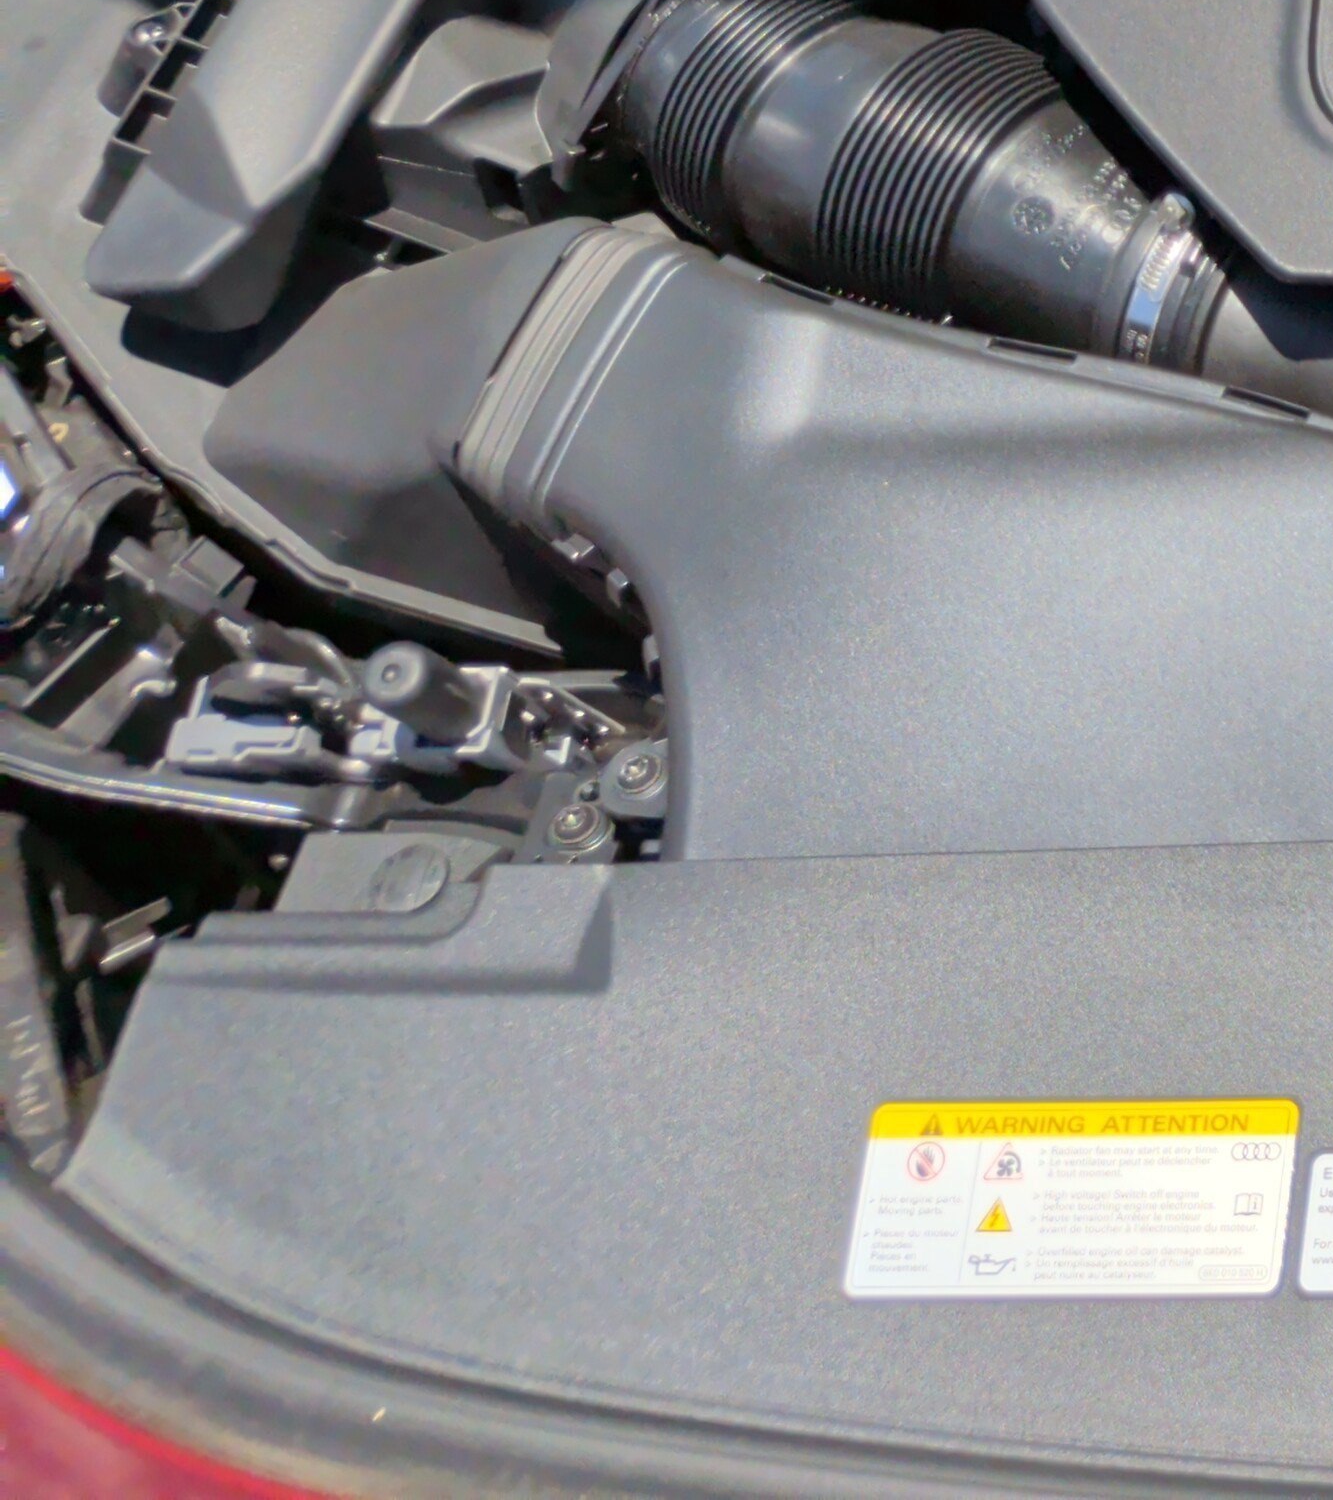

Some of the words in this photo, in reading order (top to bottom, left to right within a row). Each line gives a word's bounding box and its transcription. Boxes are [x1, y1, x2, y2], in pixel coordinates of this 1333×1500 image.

[955, 1115, 1086, 1135] WARNING
[1100, 1113, 1250, 1133] ATTENTION
[1050, 1145, 1092, 1156] Radiator
[1095, 1145, 1111, 1156] fan
[1113, 1147, 1135, 1157] may
[1137, 1146, 1160, 1155] start
[1162, 1146, 1172, 1155] at
[1174, 1147, 1192, 1156] any
[1049, 1157, 1061, 1167] Le
[1063, 1157, 1117, 1167] ventilateur
[1119, 1157, 1141, 1169] peut
[1143, 1158, 1154, 1167] se
[1056, 1168, 1076, 1178] tout
[1044, 1189, 1066, 1203] High
[1113, 1188, 1147, 1199] Switch
[1150, 1188, 1164, 1199] off
[1165, 1189, 1200, 1202] engine
[1043, 1201, 1075, 1212] before
[1077, 1201, 1120, 1213] touching
[1122, 1202, 1157, 1213] engine
[1041, 1212, 1070, 1222] Haute
[1153, 1212, 1162, 1221] le
[1165, 1212, 1201, 1221] moteur
[1039, 1224, 1067, 1234] avant
[1070, 1223, 1081, 1234] de
[1084, 1223, 1120, 1234] toucher
[1204, 1222, 1218, 1232] du
[1313, 1237, 1332, 1249] For
[1038, 1246, 1086, 1257] Overfilled
[1088, 1247, 1122, 1258] engine
[1124, 1246, 1139, 1256] oil
[1140, 1246, 1159, 1256] can
[1161, 1245, 1201, 1257] damage
[1037, 1258, 1051, 1268] Un
[1053, 1258, 1114, 1270] remplissage
[1033, 1269, 1056, 1282] peut
[1221, 1268, 1237, 1278] 010
